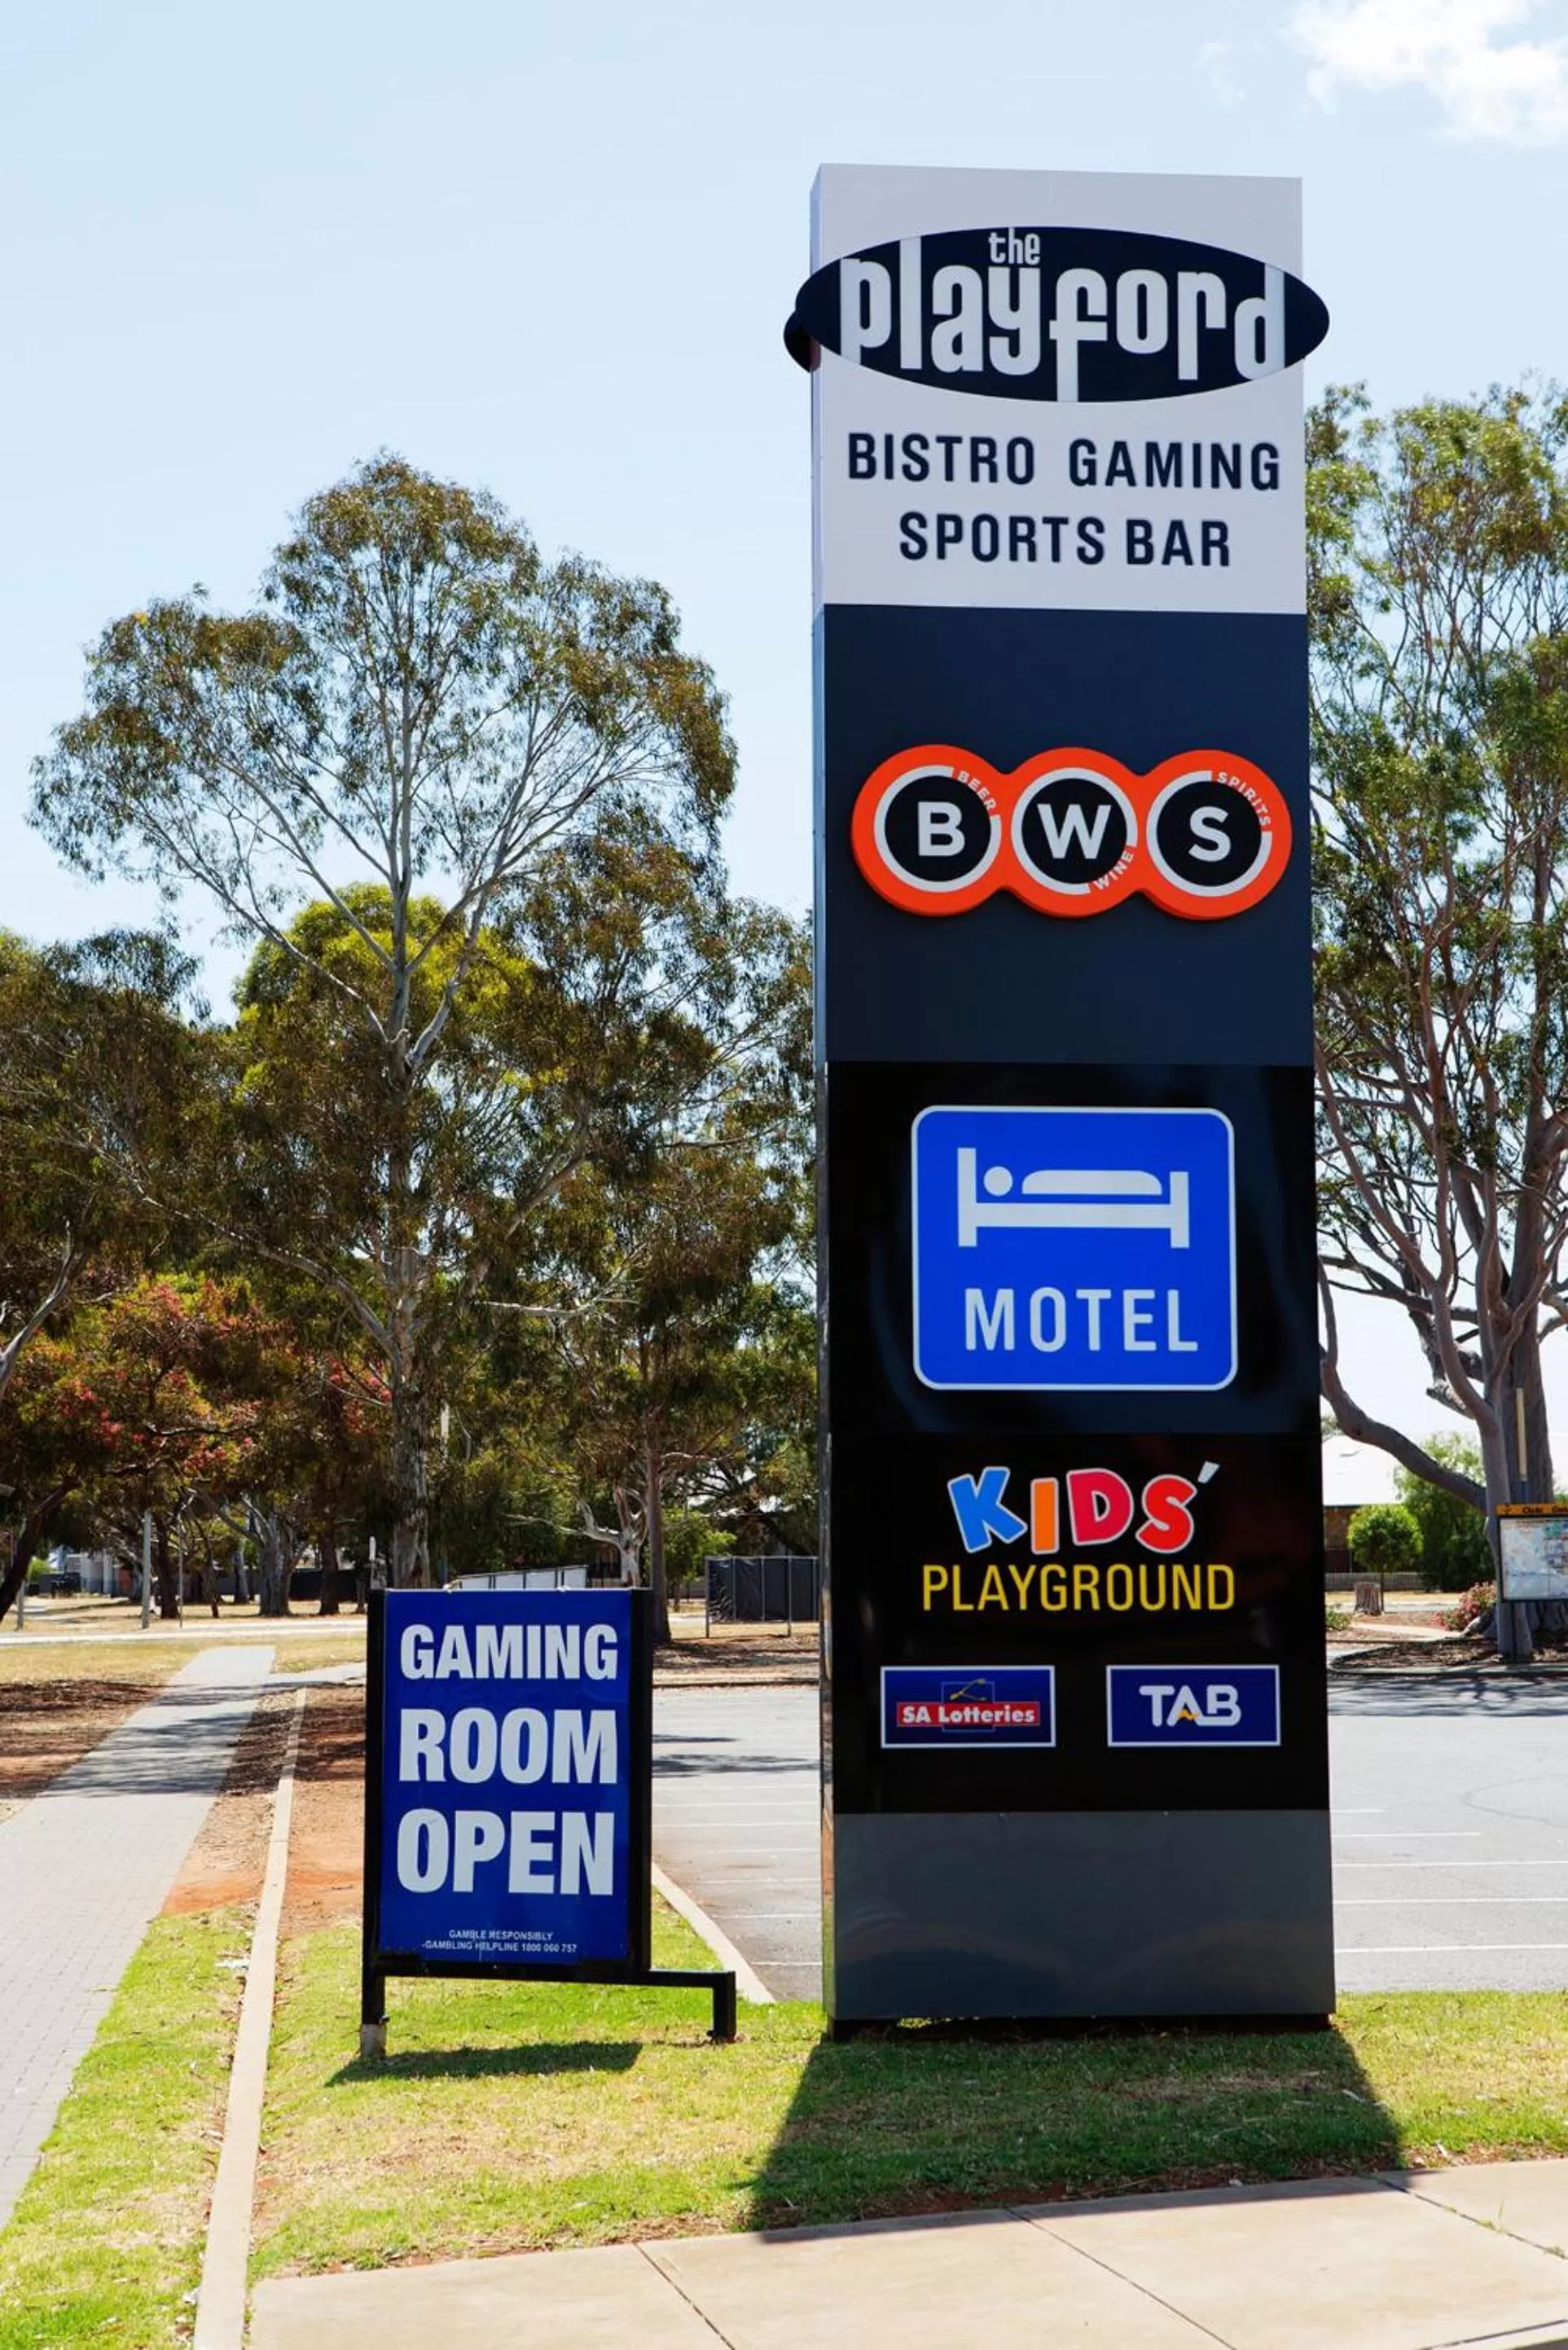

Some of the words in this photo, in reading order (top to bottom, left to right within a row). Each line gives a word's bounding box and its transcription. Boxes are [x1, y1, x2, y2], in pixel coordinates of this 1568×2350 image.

[988, 227, 1040, 265] the
[839, 235, 1285, 402] playford
[848, 433, 1034, 485] BISTRO
[1069, 438, 1280, 490] GAMING
[899, 512, 1105, 564] SPORTS
[1126, 519, 1231, 567] BAR
[957, 770, 996, 810] BEER
[1218, 771, 1271, 826] SPIRITS
[1092, 850, 1133, 889] WINE
[965, 1287, 1198, 1352] MOTEL
[923, 1565, 1235, 1610] PLAYGROUND
[400, 1624, 618, 1680] GAMING
[903, 1706, 931, 1723] SA
[938, 1705, 1034, 1723] Lotteries
[1140, 1685, 1241, 1726] TAB
[398, 1707, 617, 1784] ROOM
[397, 1808, 615, 1895] OPEN
[449, 1930, 486, 1939] GAMBLE
[489, 1931, 554, 1940] RESPONSIBLY
[475, 1941, 519, 1952] HELPLINE
